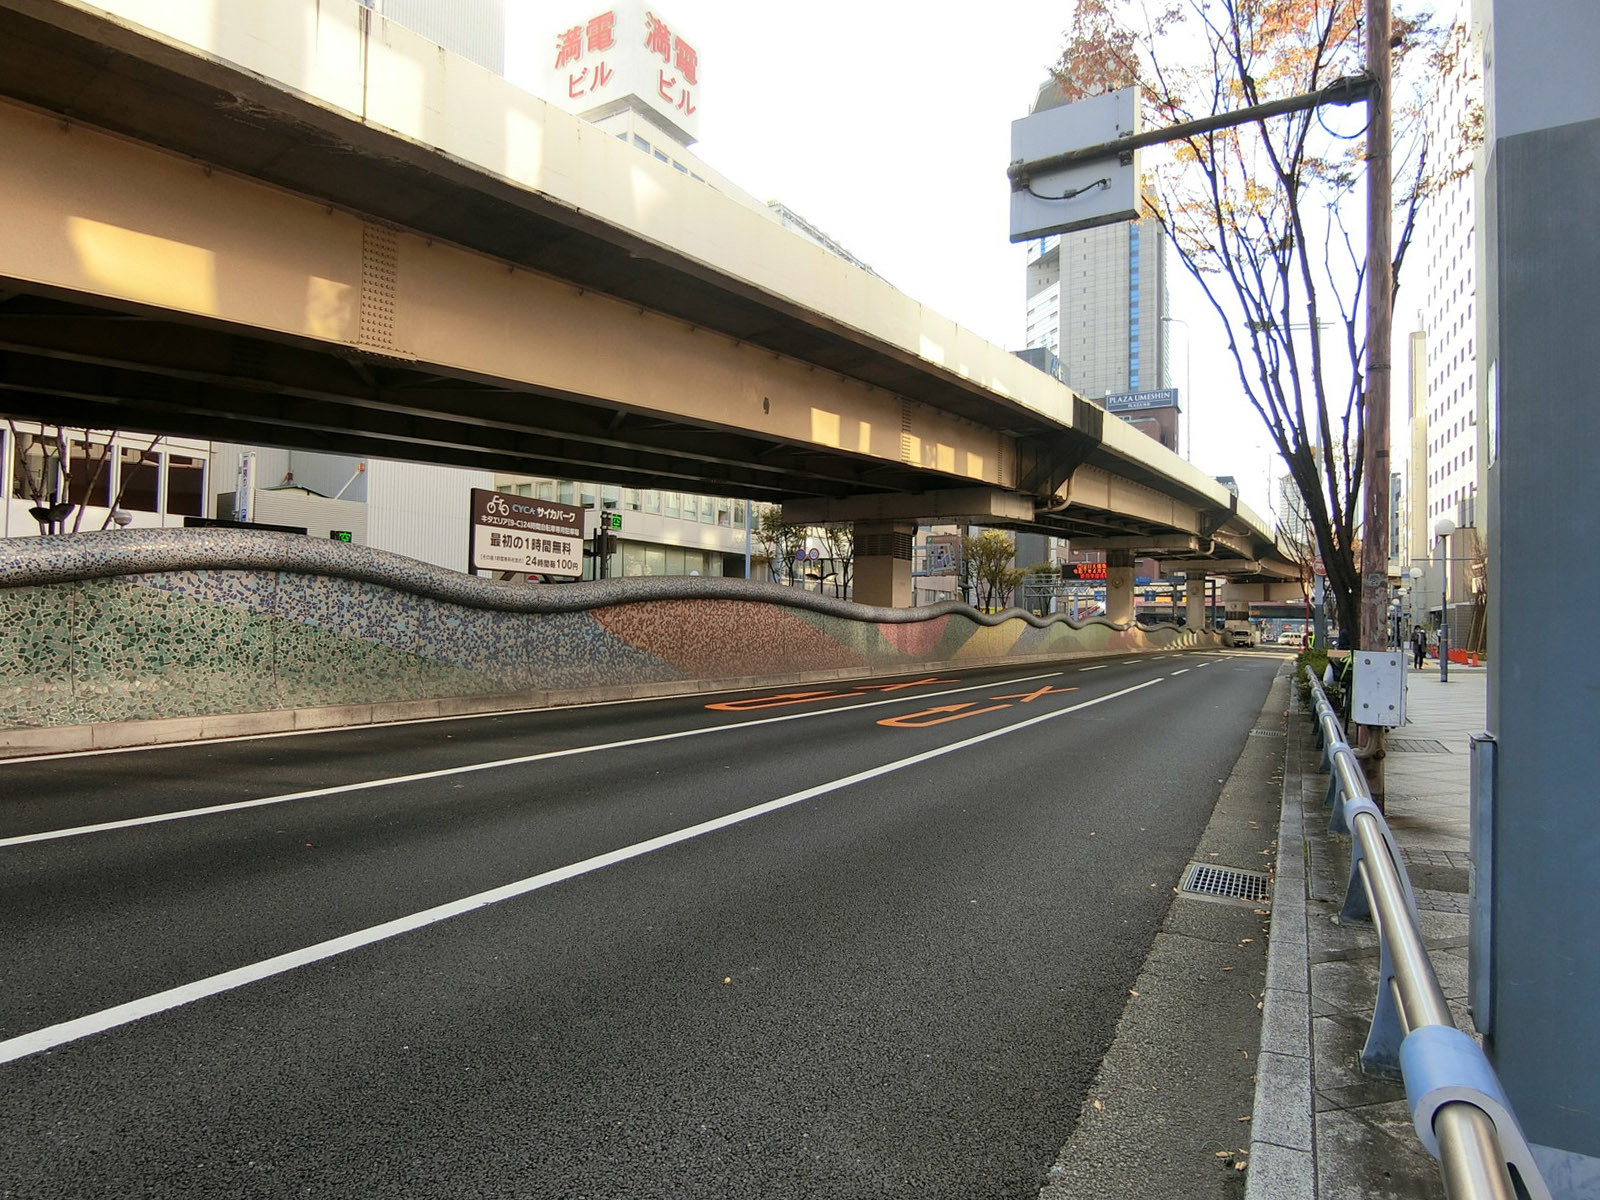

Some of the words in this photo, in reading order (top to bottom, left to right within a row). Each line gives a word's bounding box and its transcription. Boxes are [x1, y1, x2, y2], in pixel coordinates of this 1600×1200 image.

[555, 10, 615, 69] 満電
[645, 11, 698, 86] 満電
[568, 61, 612, 98] ビル
[657, 68, 696, 115] ビル
[1109, 395, 1133, 404] PLAZA
[1134, 392, 1171, 402] UMESHIN
[512, 504, 536, 515] CYCA
[490, 532, 571, 556] 最初の1時間無料
